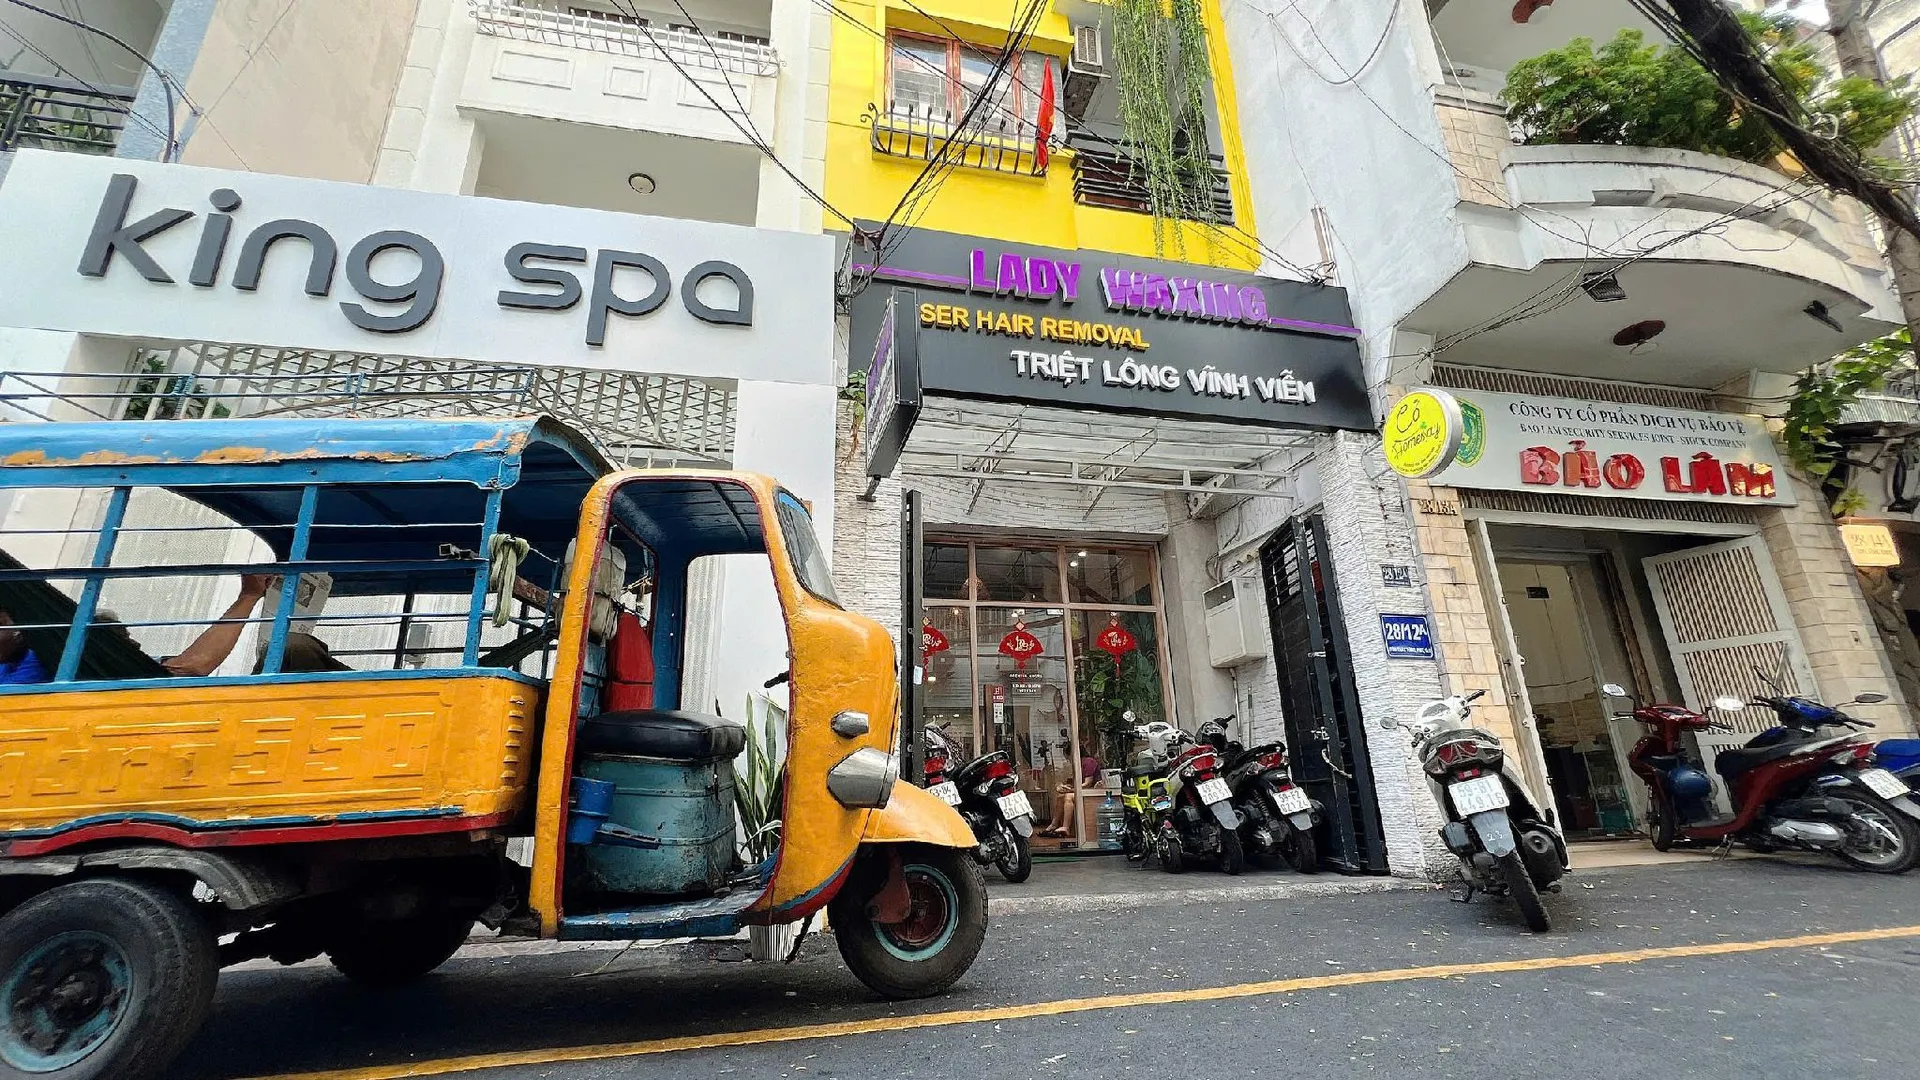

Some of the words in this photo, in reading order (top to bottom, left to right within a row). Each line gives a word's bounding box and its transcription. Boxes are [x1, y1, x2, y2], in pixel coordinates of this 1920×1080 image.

[77, 172, 445, 334] king
[496, 240, 754, 346] spa
[969, 248, 1081, 303] LADY
[977, 309, 1035, 337] HAIR
[1040, 317, 1150, 350] REMOVAL
[1010, 349, 1094, 387] TRIỆT
[1101, 356, 1180, 391] LÔNG
[1186, 364, 1251, 399] VĨNH
[1254, 367, 1317, 404] VIỄN
[1509, 401, 1551, 419] CÔNG
[1554, 407, 1574, 421] TY
[1600, 406, 1639, 427] PHẦN
[1678, 418, 1697, 433] VỤ
[1699, 417, 1728, 434] BẢO
[1562, 426, 1606, 439] SECURITY
[1607, 429, 1649, 443] SERVICES
[1651, 433, 1675, 445] JOINT
[1519, 440, 1645, 490] BẢO
[1660, 451, 1776, 498] LÂM
[1385, 622, 1428, 641] 28/12A
